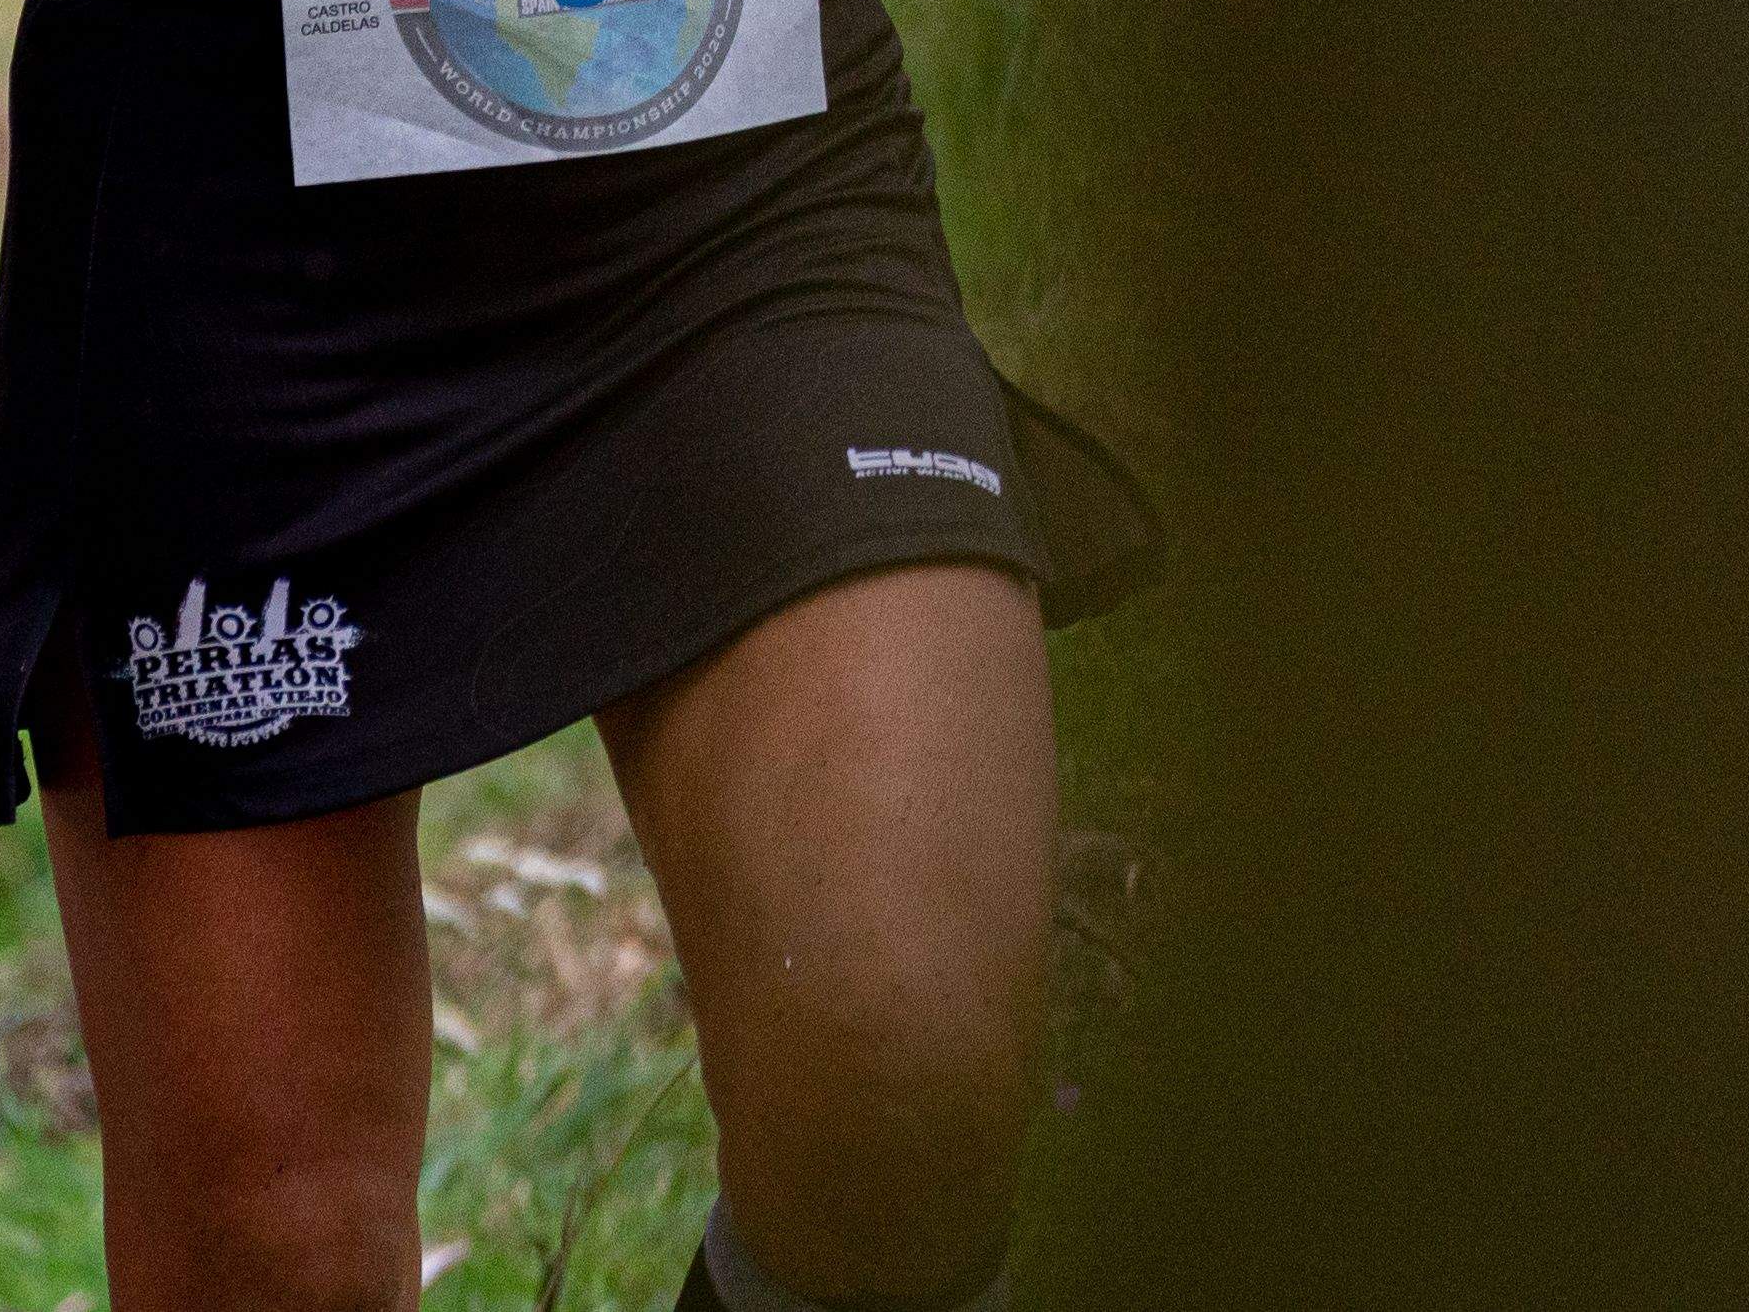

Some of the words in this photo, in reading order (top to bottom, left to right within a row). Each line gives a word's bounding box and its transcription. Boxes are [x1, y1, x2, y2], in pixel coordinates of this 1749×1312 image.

[300, 15, 380, 36] CALDELAS
[307, 0, 371, 20] CASTRO
[438, 60, 513, 123] WORLD
[520, 78, 693, 141] CHAMPIONSHIP
[693, 23, 728, 81] 2020
[134, 636, 337, 685] PERLAS
[139, 695, 257, 727] COLMENAR
[270, 690, 342, 705] VIEJO
